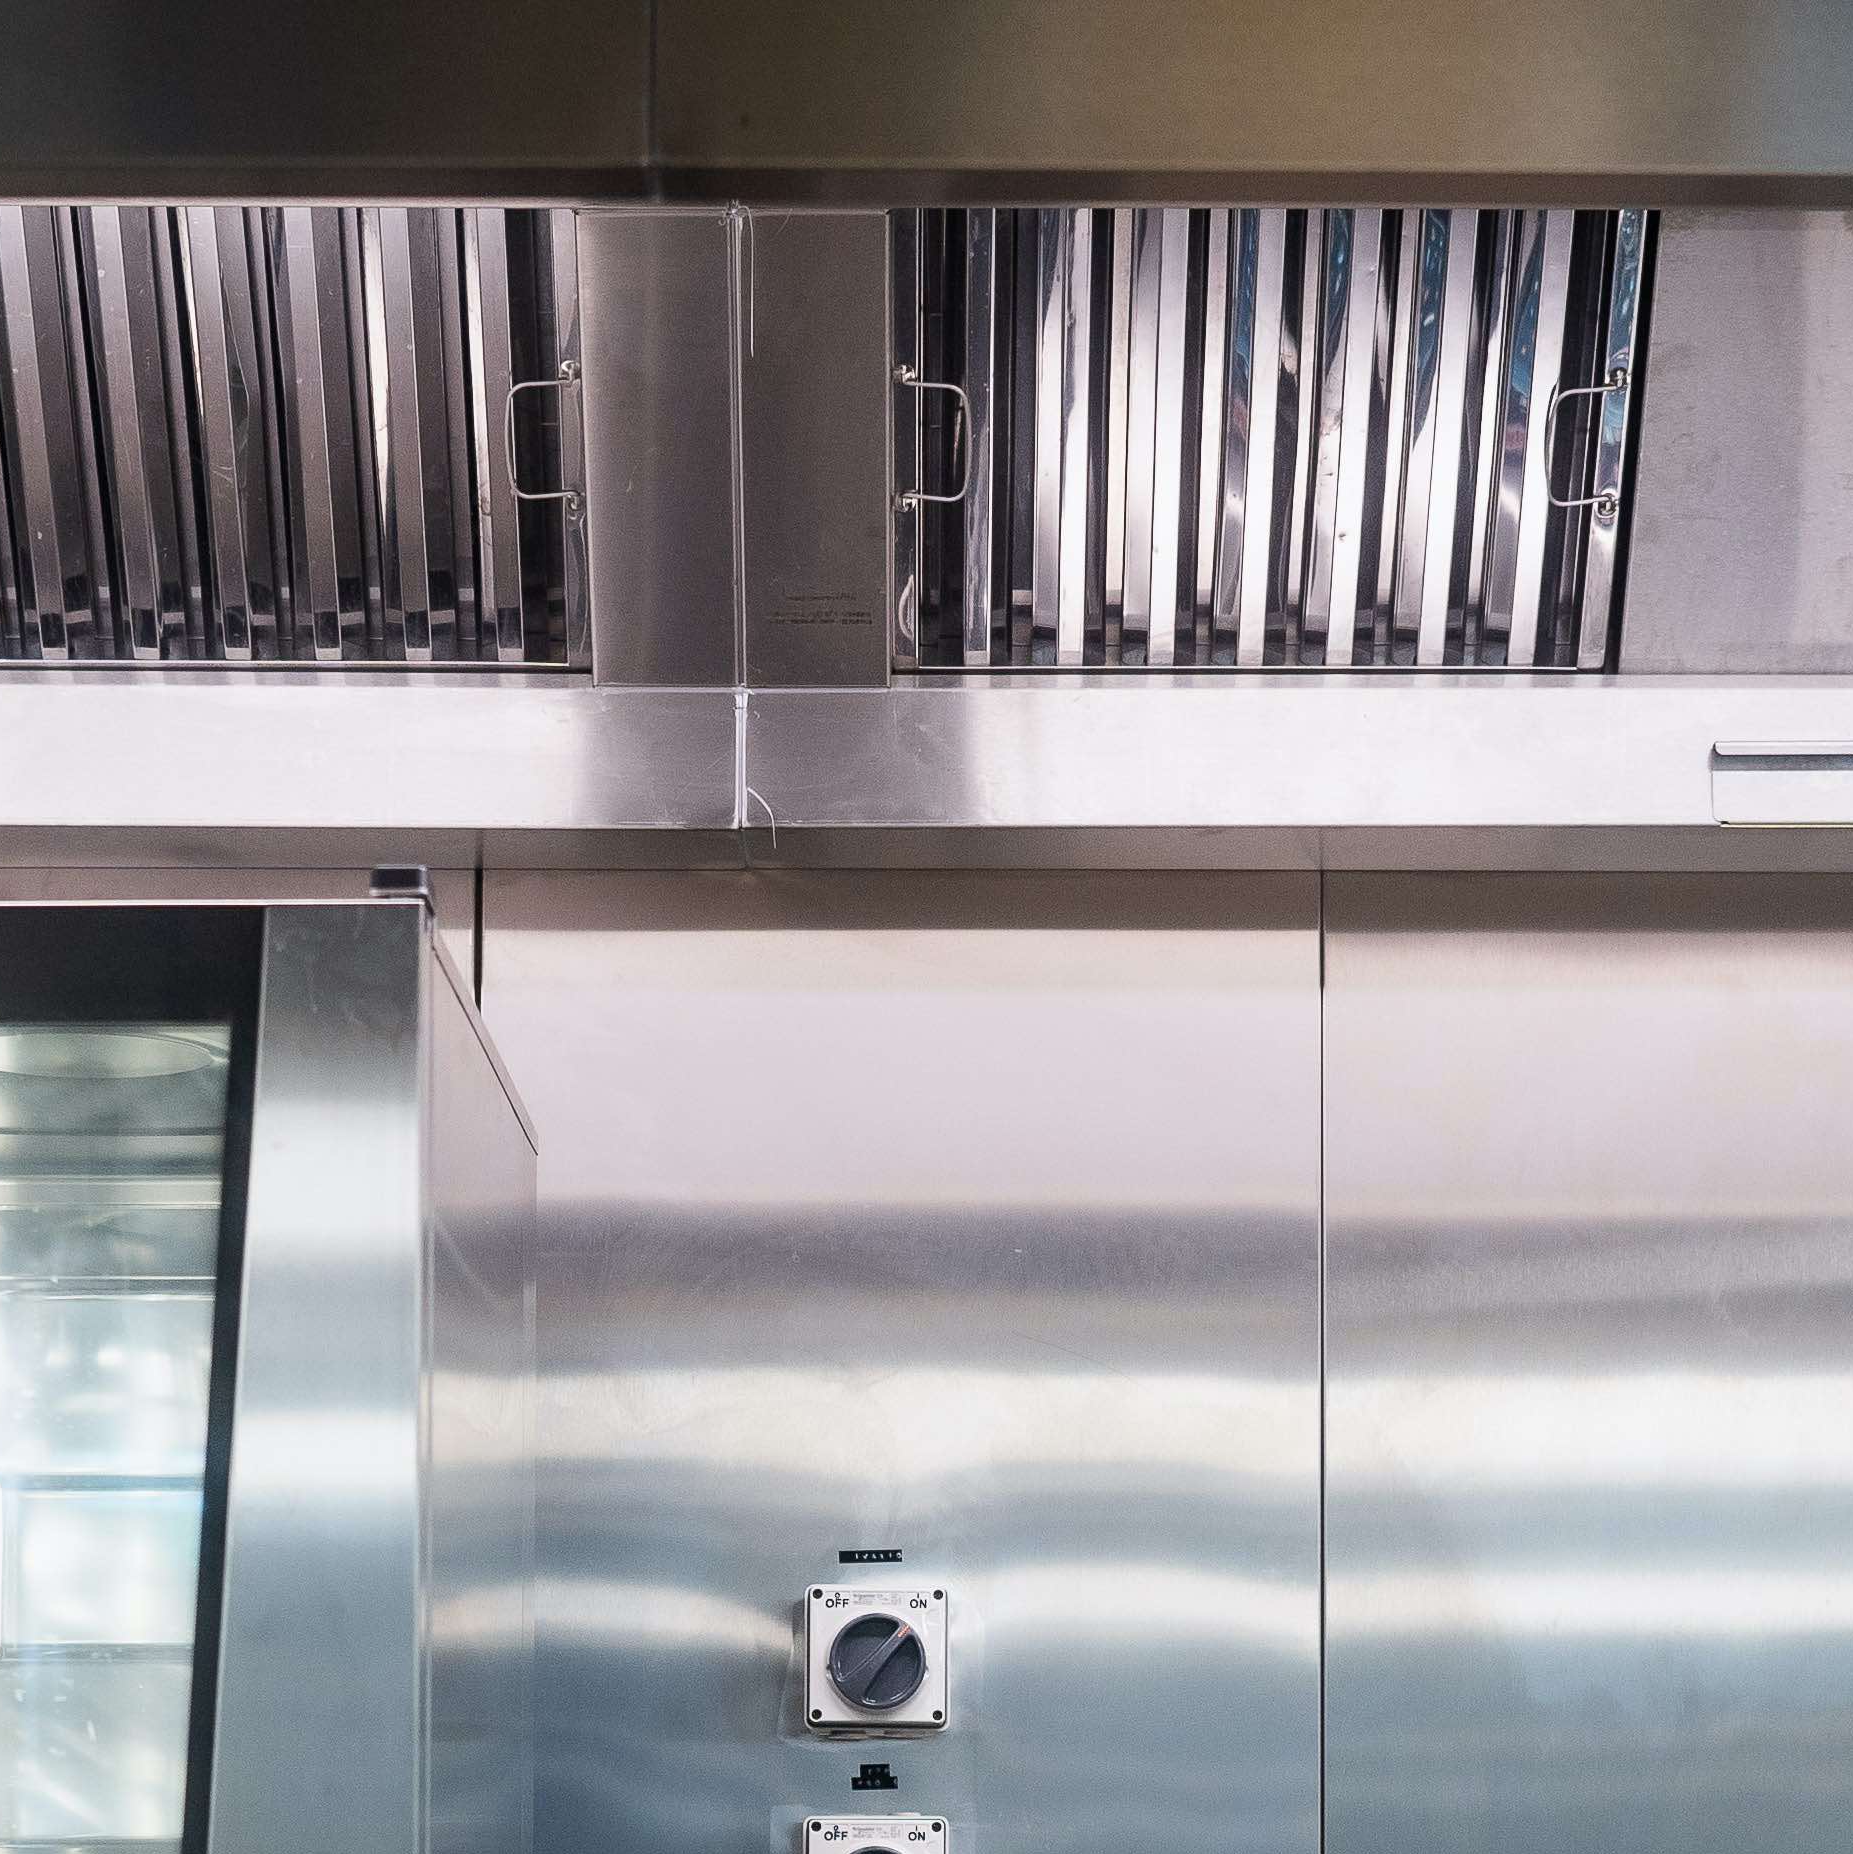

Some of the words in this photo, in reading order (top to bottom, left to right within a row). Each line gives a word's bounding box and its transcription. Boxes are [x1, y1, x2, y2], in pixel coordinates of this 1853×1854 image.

[825, 1598, 849, 1608] OFF
[909, 1598, 927, 1609] ON
[824, 1831, 848, 1841] OFF
[908, 1831, 926, 1841] ON
